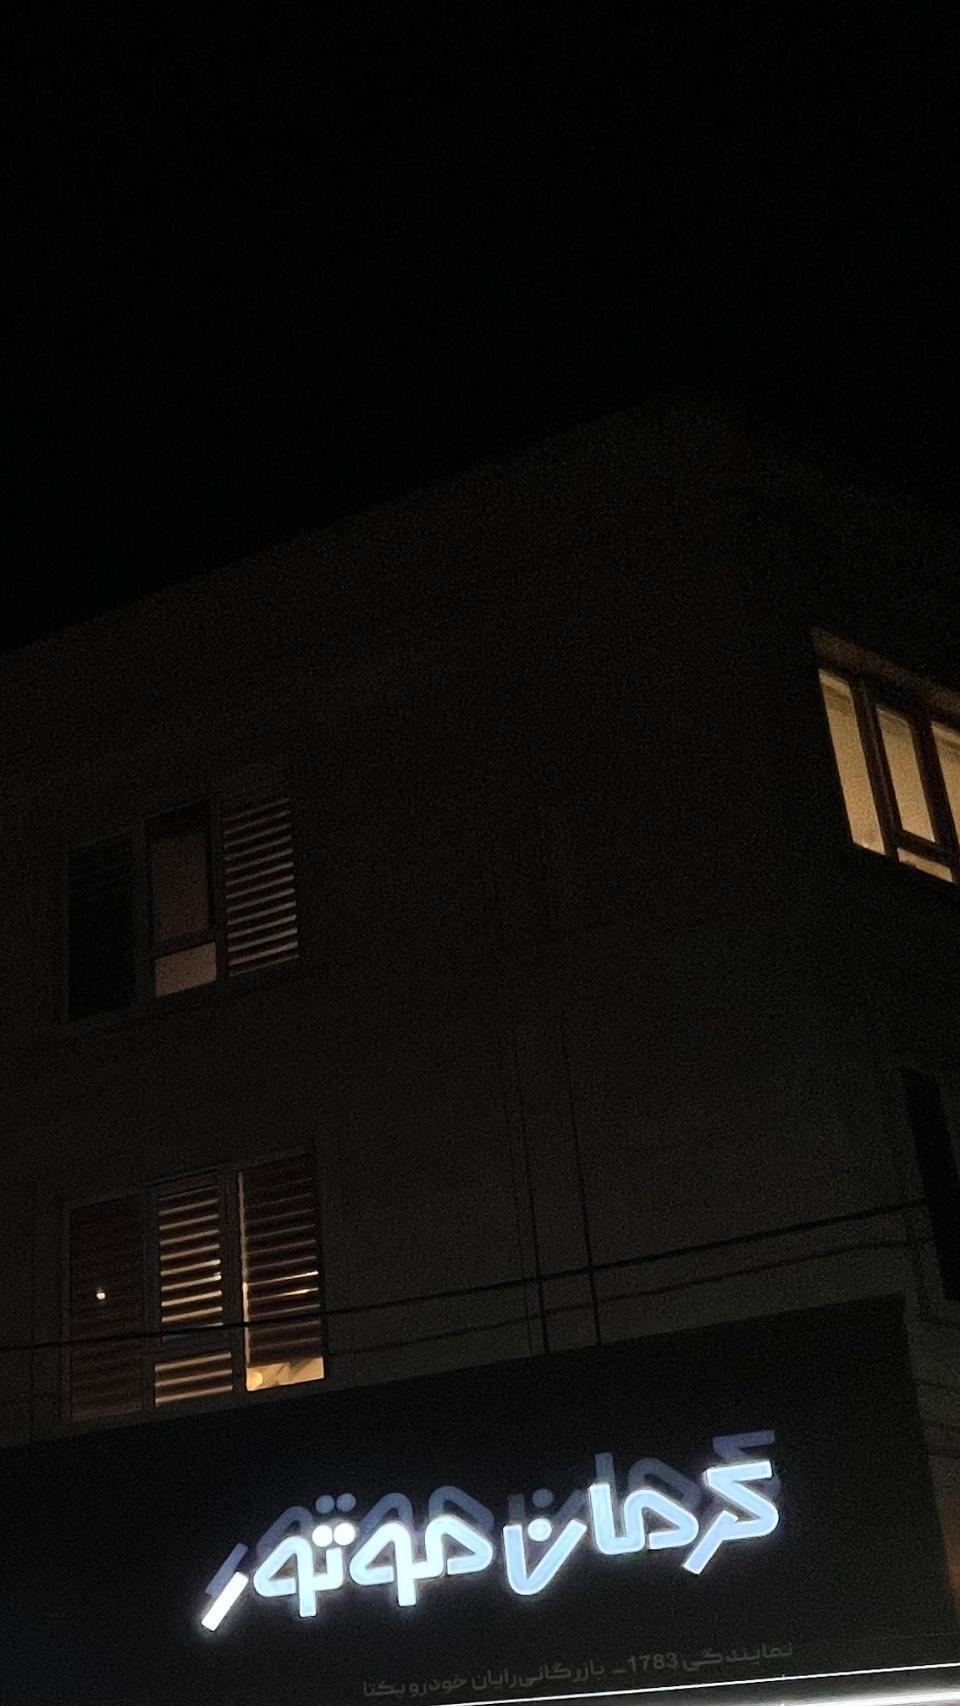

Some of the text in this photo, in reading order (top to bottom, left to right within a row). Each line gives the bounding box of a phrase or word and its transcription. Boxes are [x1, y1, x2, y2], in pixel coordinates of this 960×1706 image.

[201, 1460, 779, 1631] کرمان موتور
[682, 1642, 794, 1672] نمایندگی
[519, 1659, 606, 1688] بازرگانی
